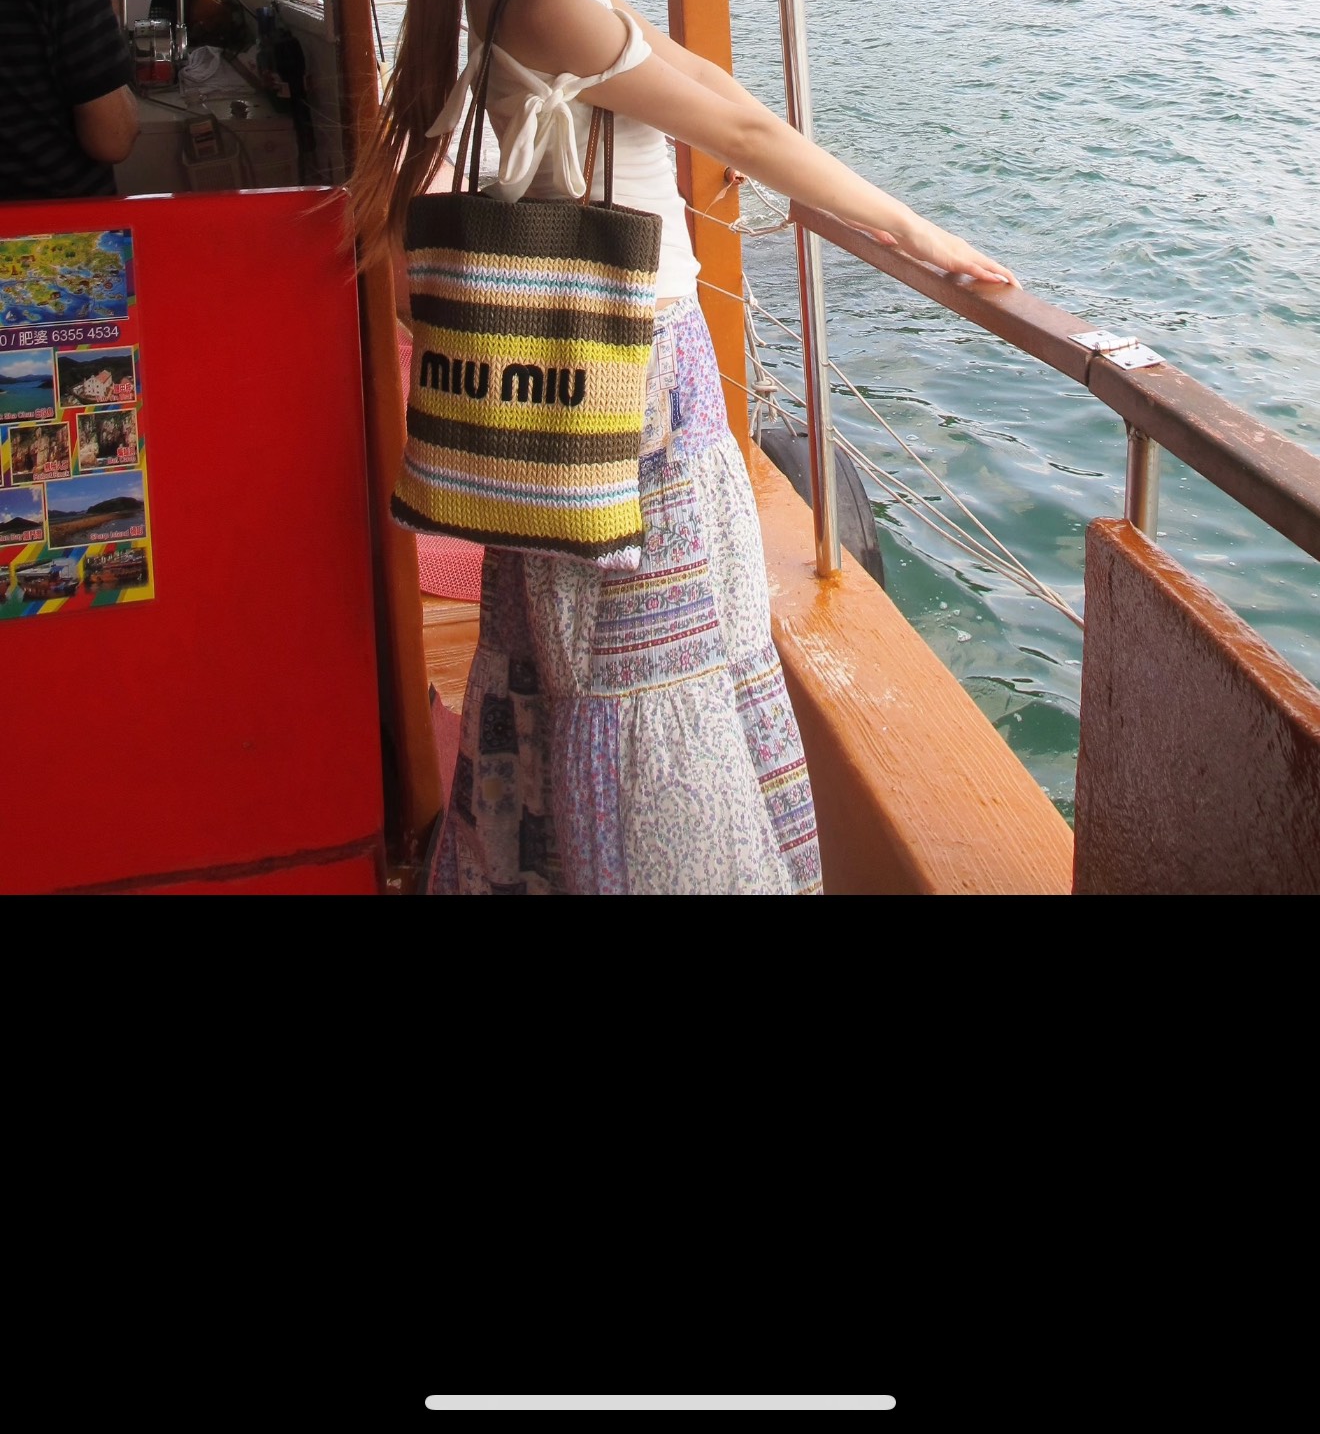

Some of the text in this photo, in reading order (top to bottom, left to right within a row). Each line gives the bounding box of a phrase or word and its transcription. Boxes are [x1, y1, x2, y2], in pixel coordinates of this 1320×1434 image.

[19, 330, 49, 346] 肥婆
[52, 328, 84, 342] 6355
[87, 326, 119, 339] 4534
